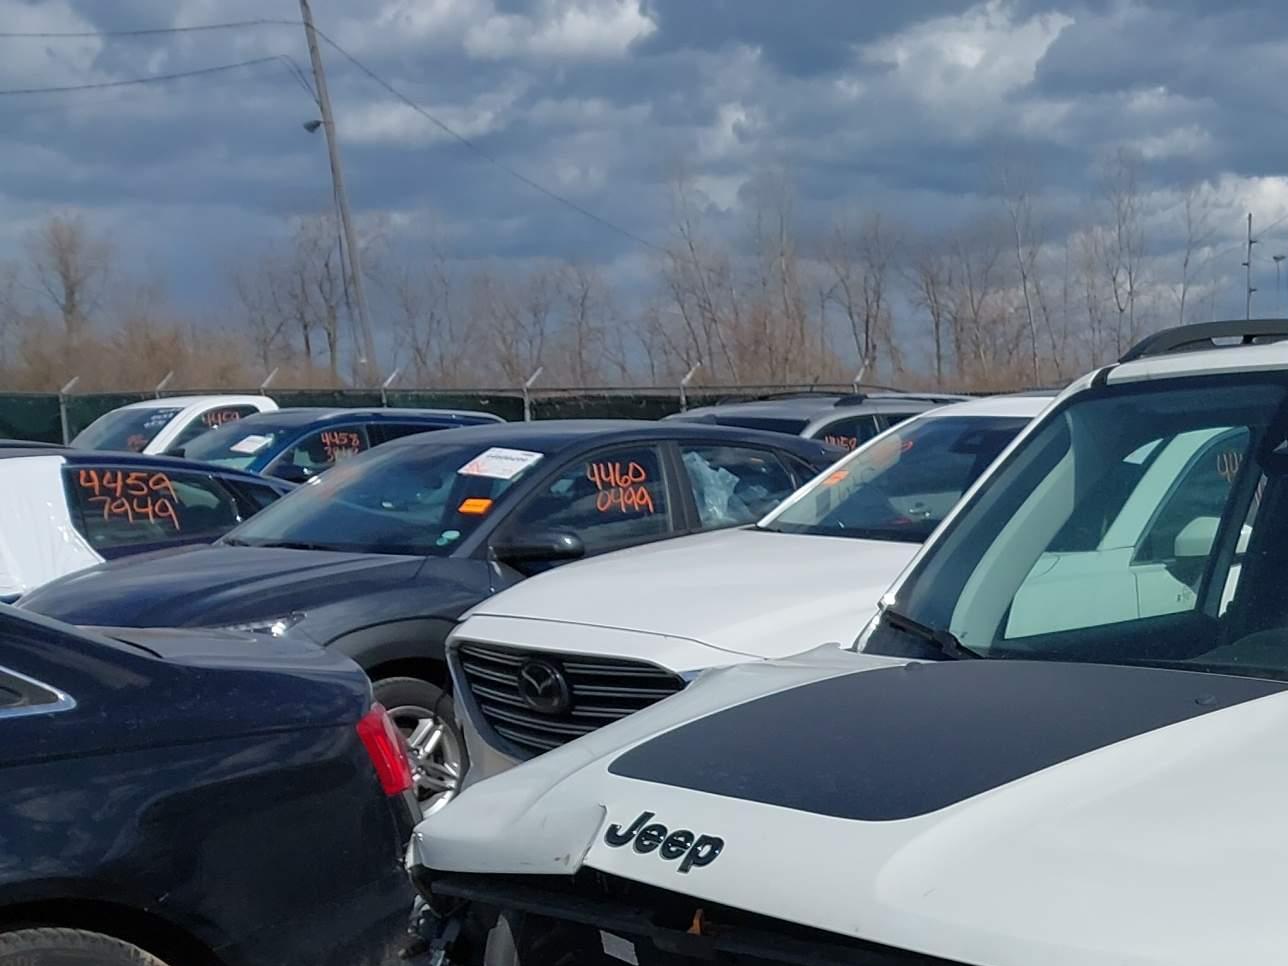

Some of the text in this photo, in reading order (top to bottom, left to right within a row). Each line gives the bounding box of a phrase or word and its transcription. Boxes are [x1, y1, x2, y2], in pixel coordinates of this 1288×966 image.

[79, 469, 178, 504] 4459
[587, 461, 646, 490] 4460
[88, 496, 181, 531] 7949
[597, 486, 653, 513] 0499
[604, 811, 724, 874] Jeep
